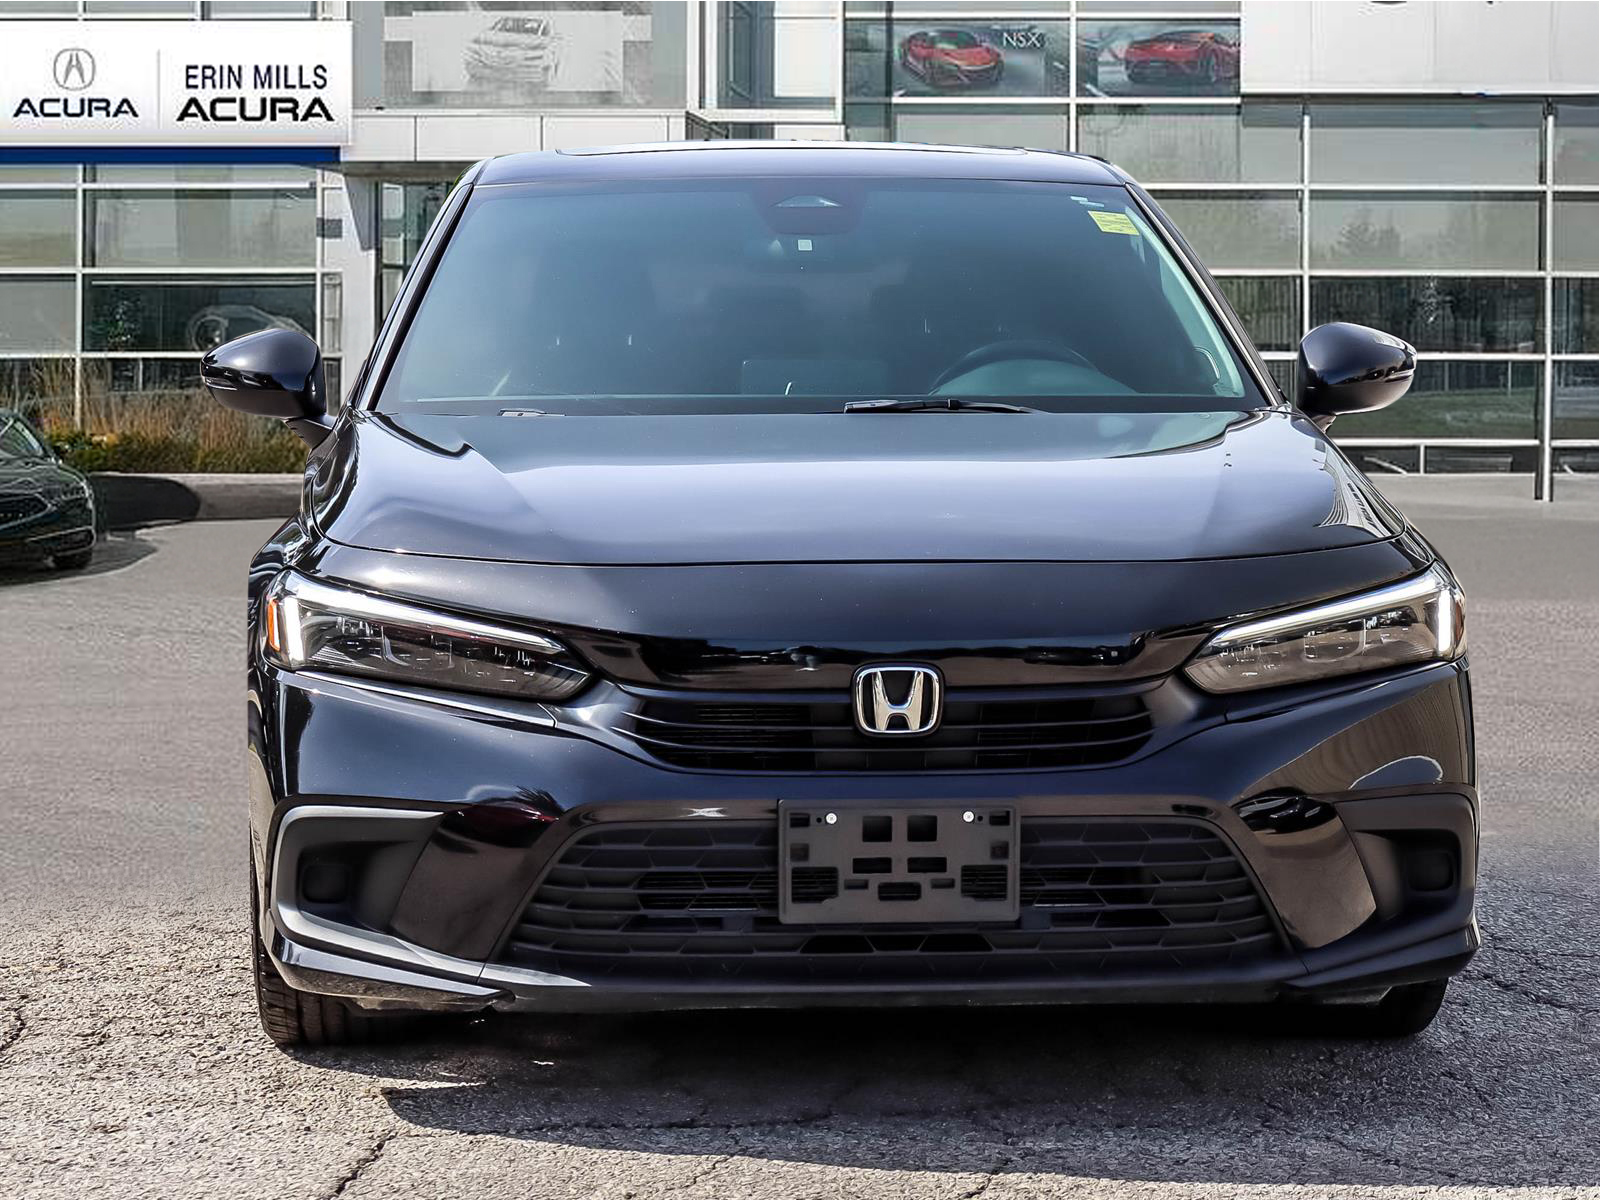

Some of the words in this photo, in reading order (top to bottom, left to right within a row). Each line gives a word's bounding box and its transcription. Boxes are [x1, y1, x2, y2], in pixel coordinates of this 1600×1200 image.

[1003, 31, 1041, 49] NSX
[185, 64, 242, 90] ERIN
[253, 64, 328, 90] MILLS
[12, 97, 139, 118] ACURA
[175, 96, 335, 122] ACURA
